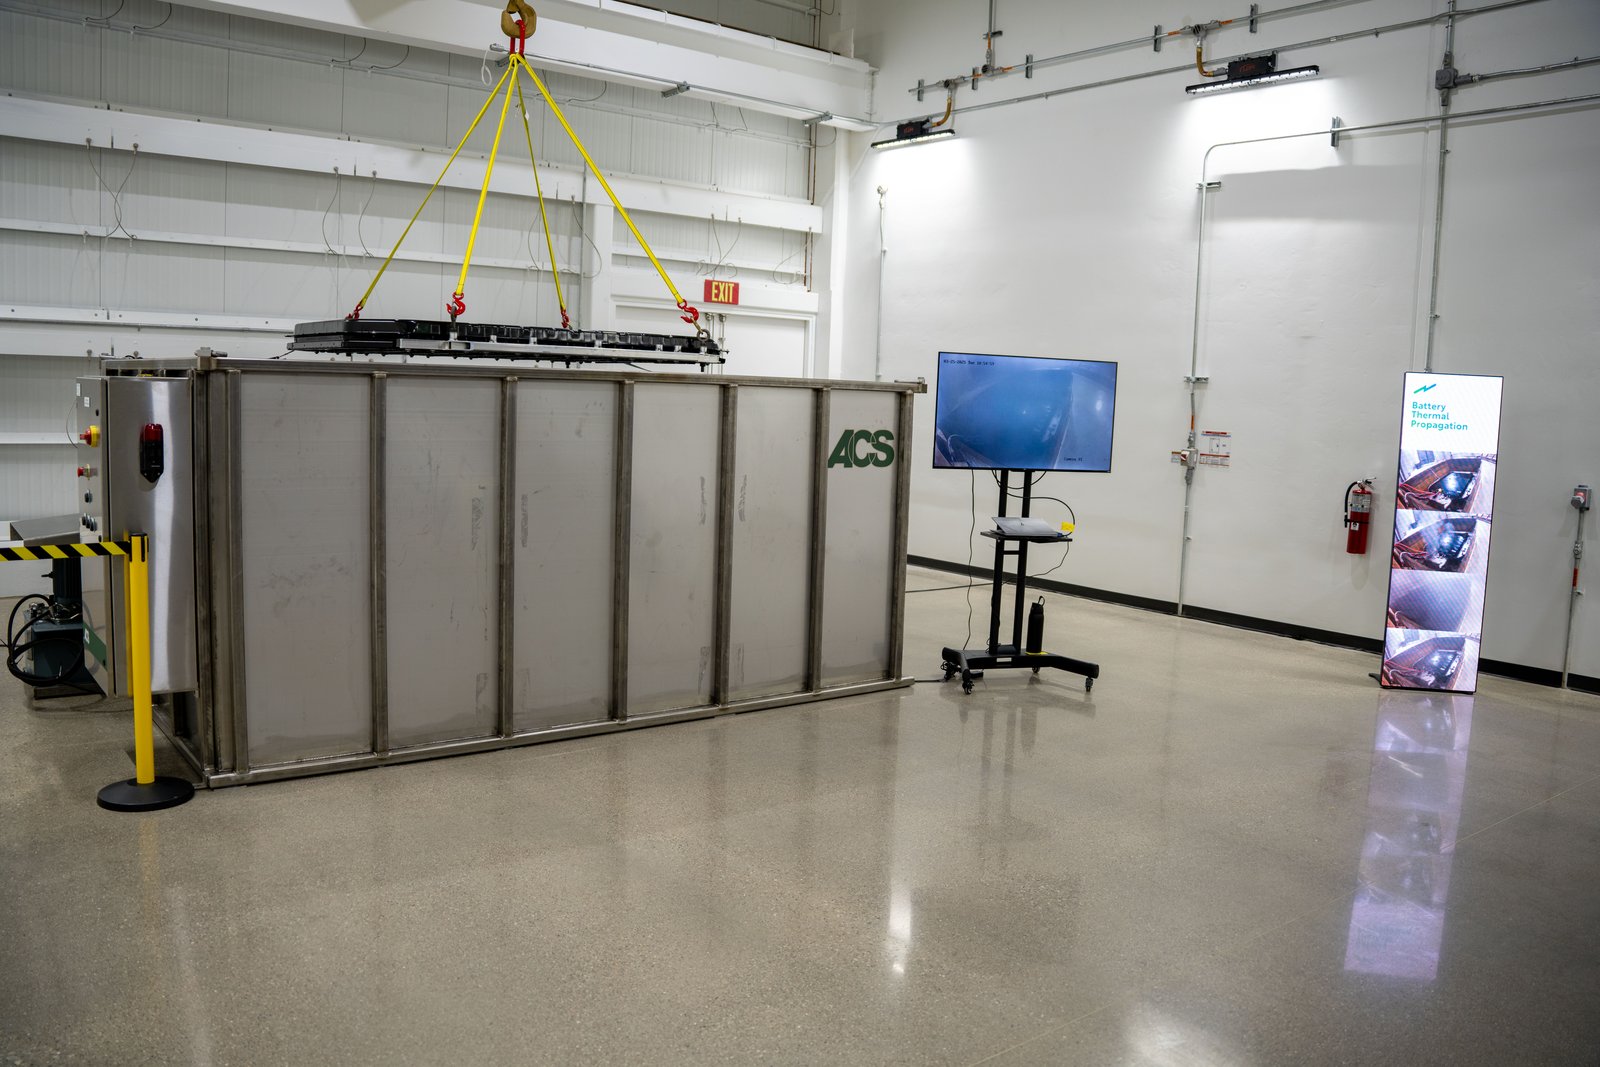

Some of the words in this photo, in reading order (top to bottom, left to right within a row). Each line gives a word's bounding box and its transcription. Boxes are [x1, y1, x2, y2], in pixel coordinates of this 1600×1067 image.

[711, 281, 735, 303] EXIT
[1412, 401, 1446, 412] Battery
[1411, 410, 1450, 420] Thermal
[1411, 419, 1468, 431] Propagation
[827, 429, 895, 469] ACS
